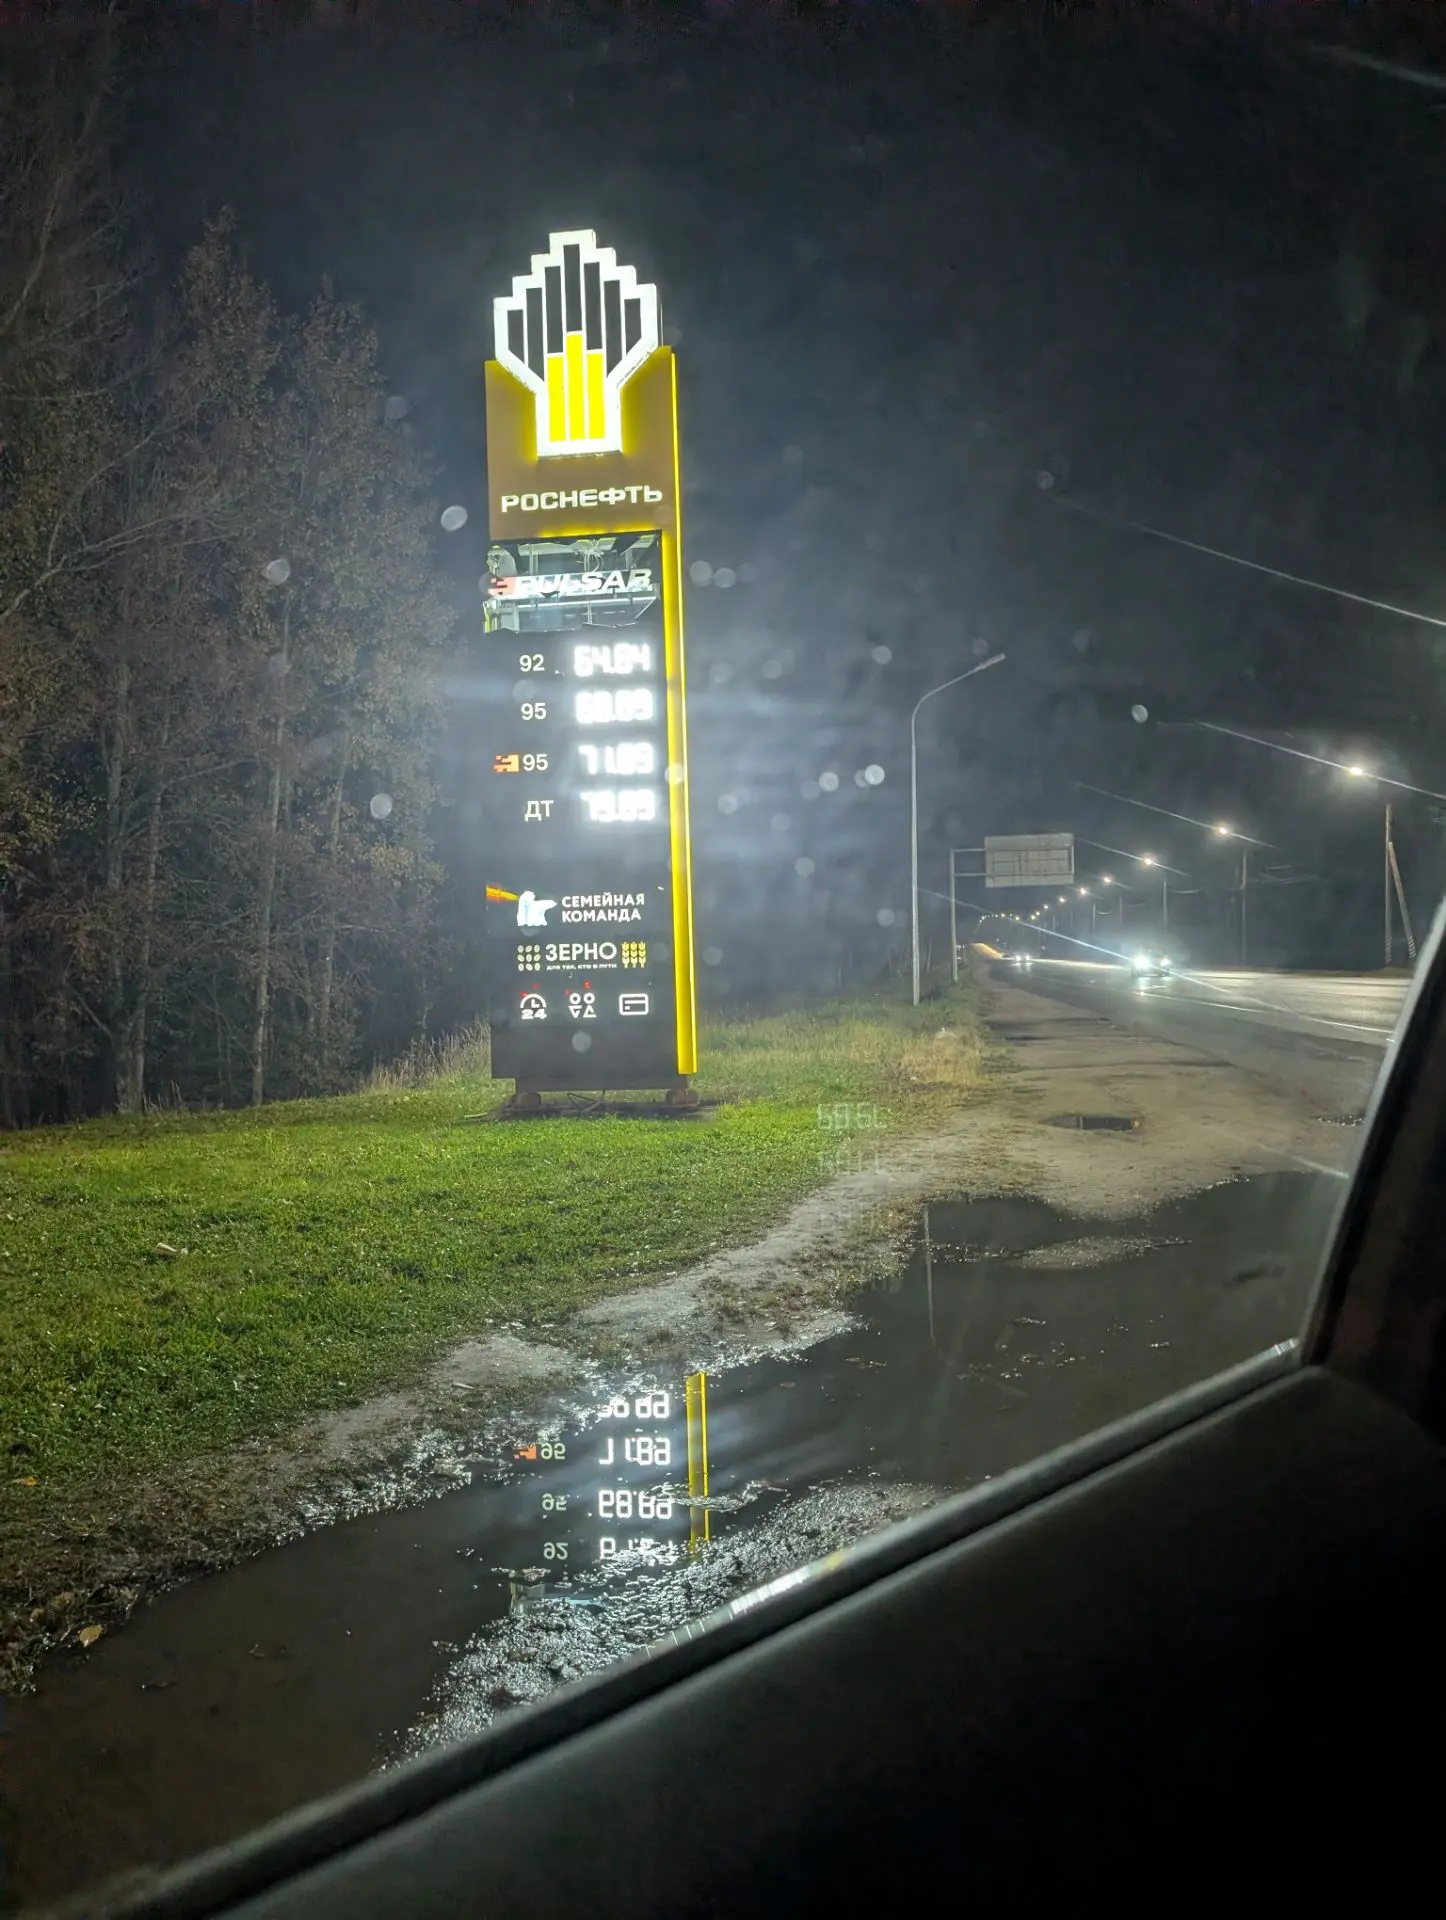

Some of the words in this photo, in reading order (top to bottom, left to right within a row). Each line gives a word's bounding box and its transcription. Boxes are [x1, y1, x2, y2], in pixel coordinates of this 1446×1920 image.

[501, 485, 663, 513] РОСНЕФТЬ
[519, 654, 545, 672] 92
[520, 702, 547, 720] 95
[522, 753, 549, 771] 95
[524, 800, 554, 822] ДТ
[561, 892, 645, 908] СЕМЕЙНАЯ
[561, 908, 642, 923] КОМАНДА
[545, 941, 618, 962] ЗЕРНО
[520, 1009, 548, 1020] 24
